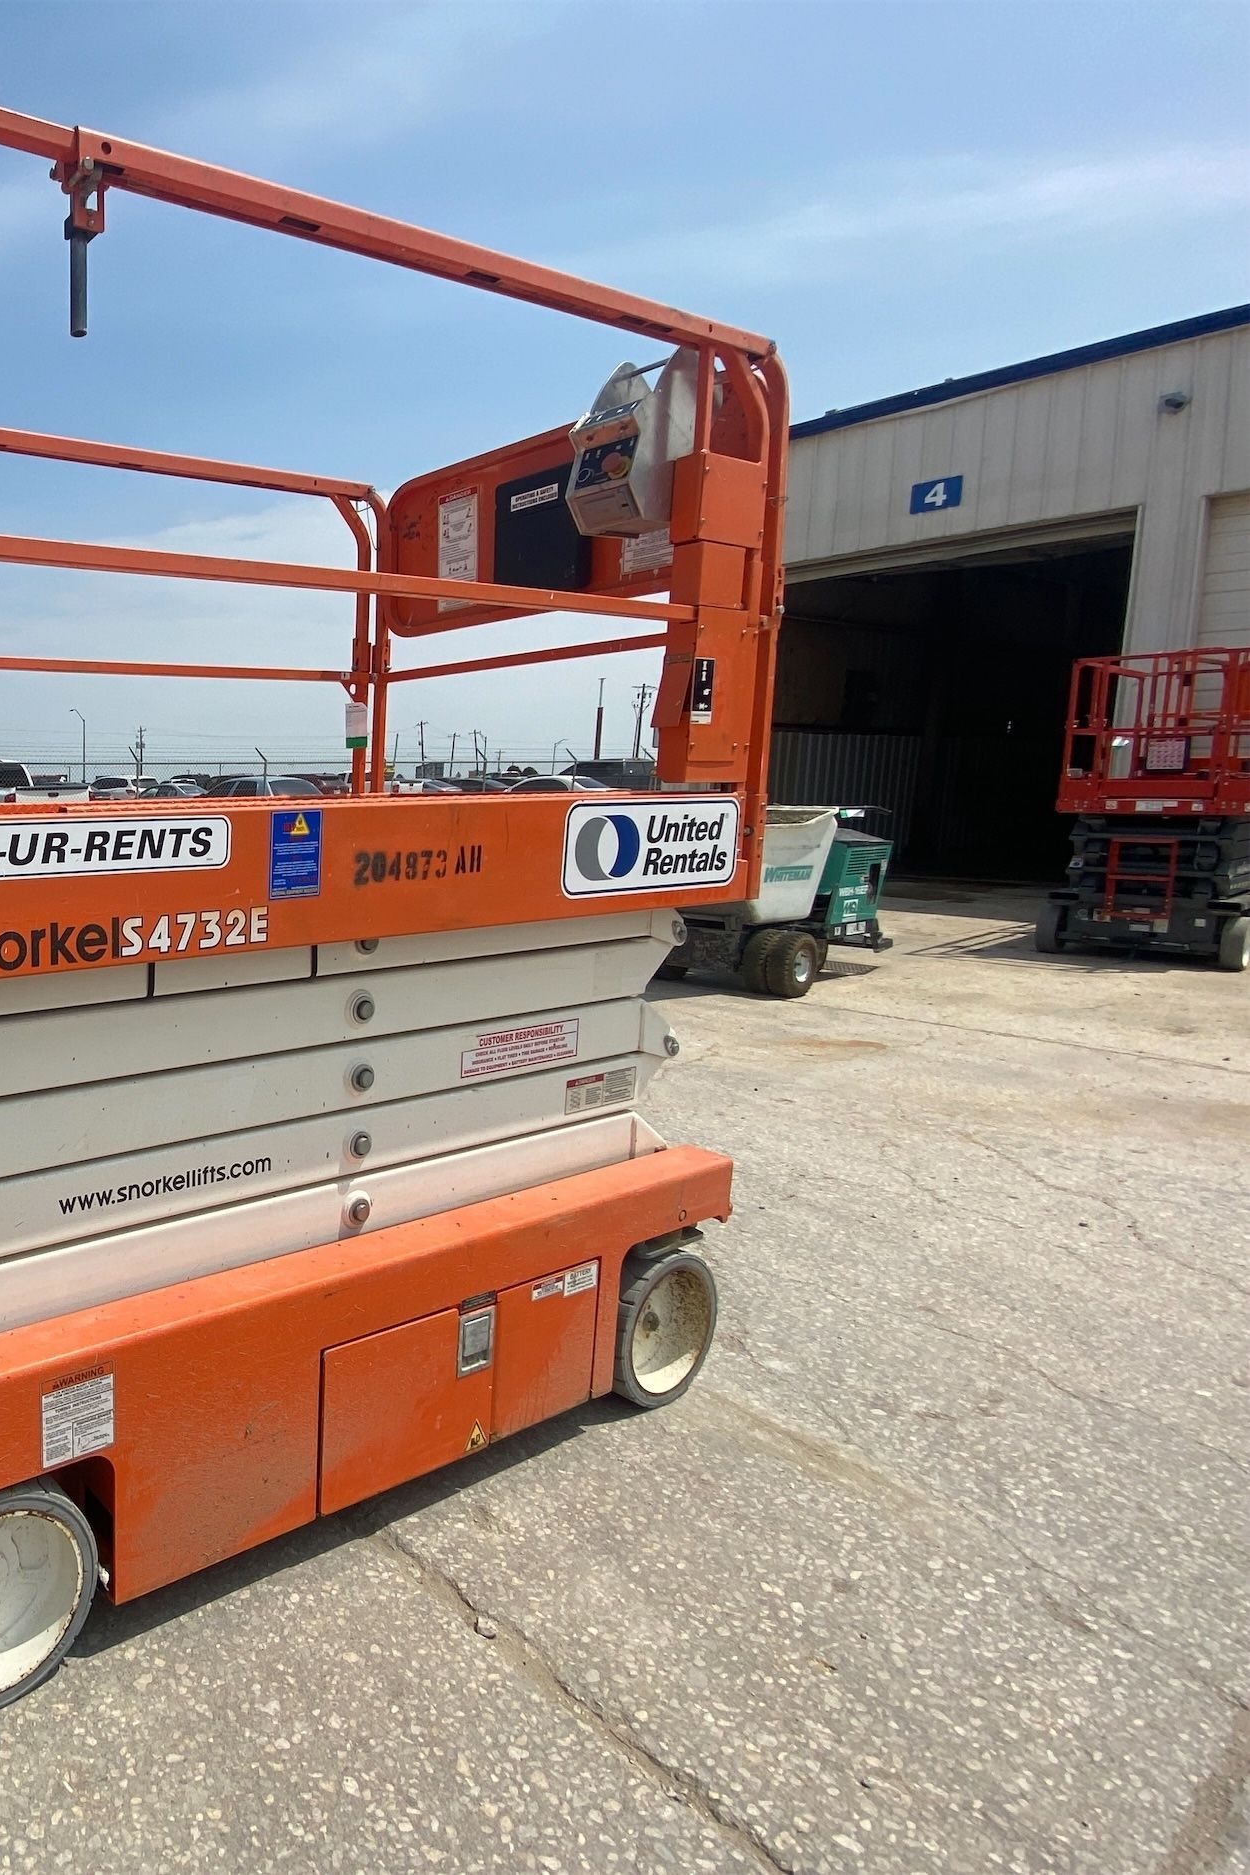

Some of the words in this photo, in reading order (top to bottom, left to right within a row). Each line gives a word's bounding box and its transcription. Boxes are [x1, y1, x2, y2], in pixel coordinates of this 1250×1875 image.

[924, 482, 947, 507] 4
[646, 813, 725, 844] United
[354, 849, 448, 886] 204873
[642, 844, 728, 876] Rentals
[121, 905, 269, 958] S4732E
[479, 1034, 514, 1047] CUSTOMER
[514, 1024, 564, 1041] RESPONSIBILITY
[59, 1156, 271, 1215] www.snorkellifts.com
[58, 1366, 104, 1388] WARNING
